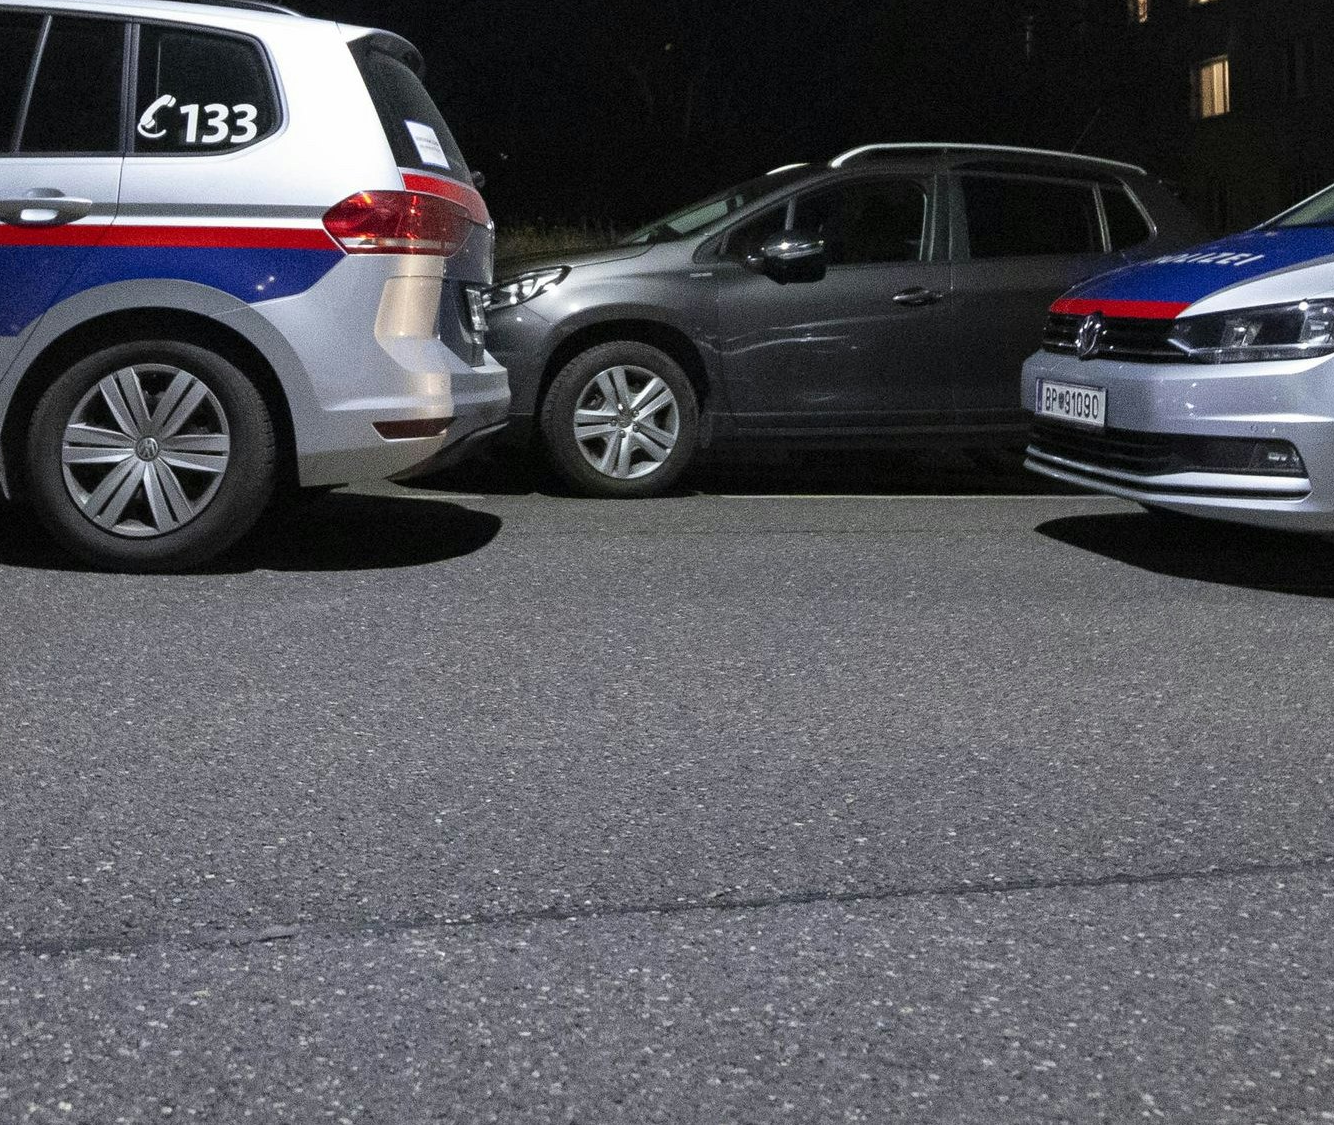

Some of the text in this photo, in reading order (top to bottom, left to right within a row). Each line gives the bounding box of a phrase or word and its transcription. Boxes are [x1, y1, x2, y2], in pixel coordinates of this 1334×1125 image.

[179, 103, 258, 143] 133
[1045, 386, 1099, 420] BP 91090
